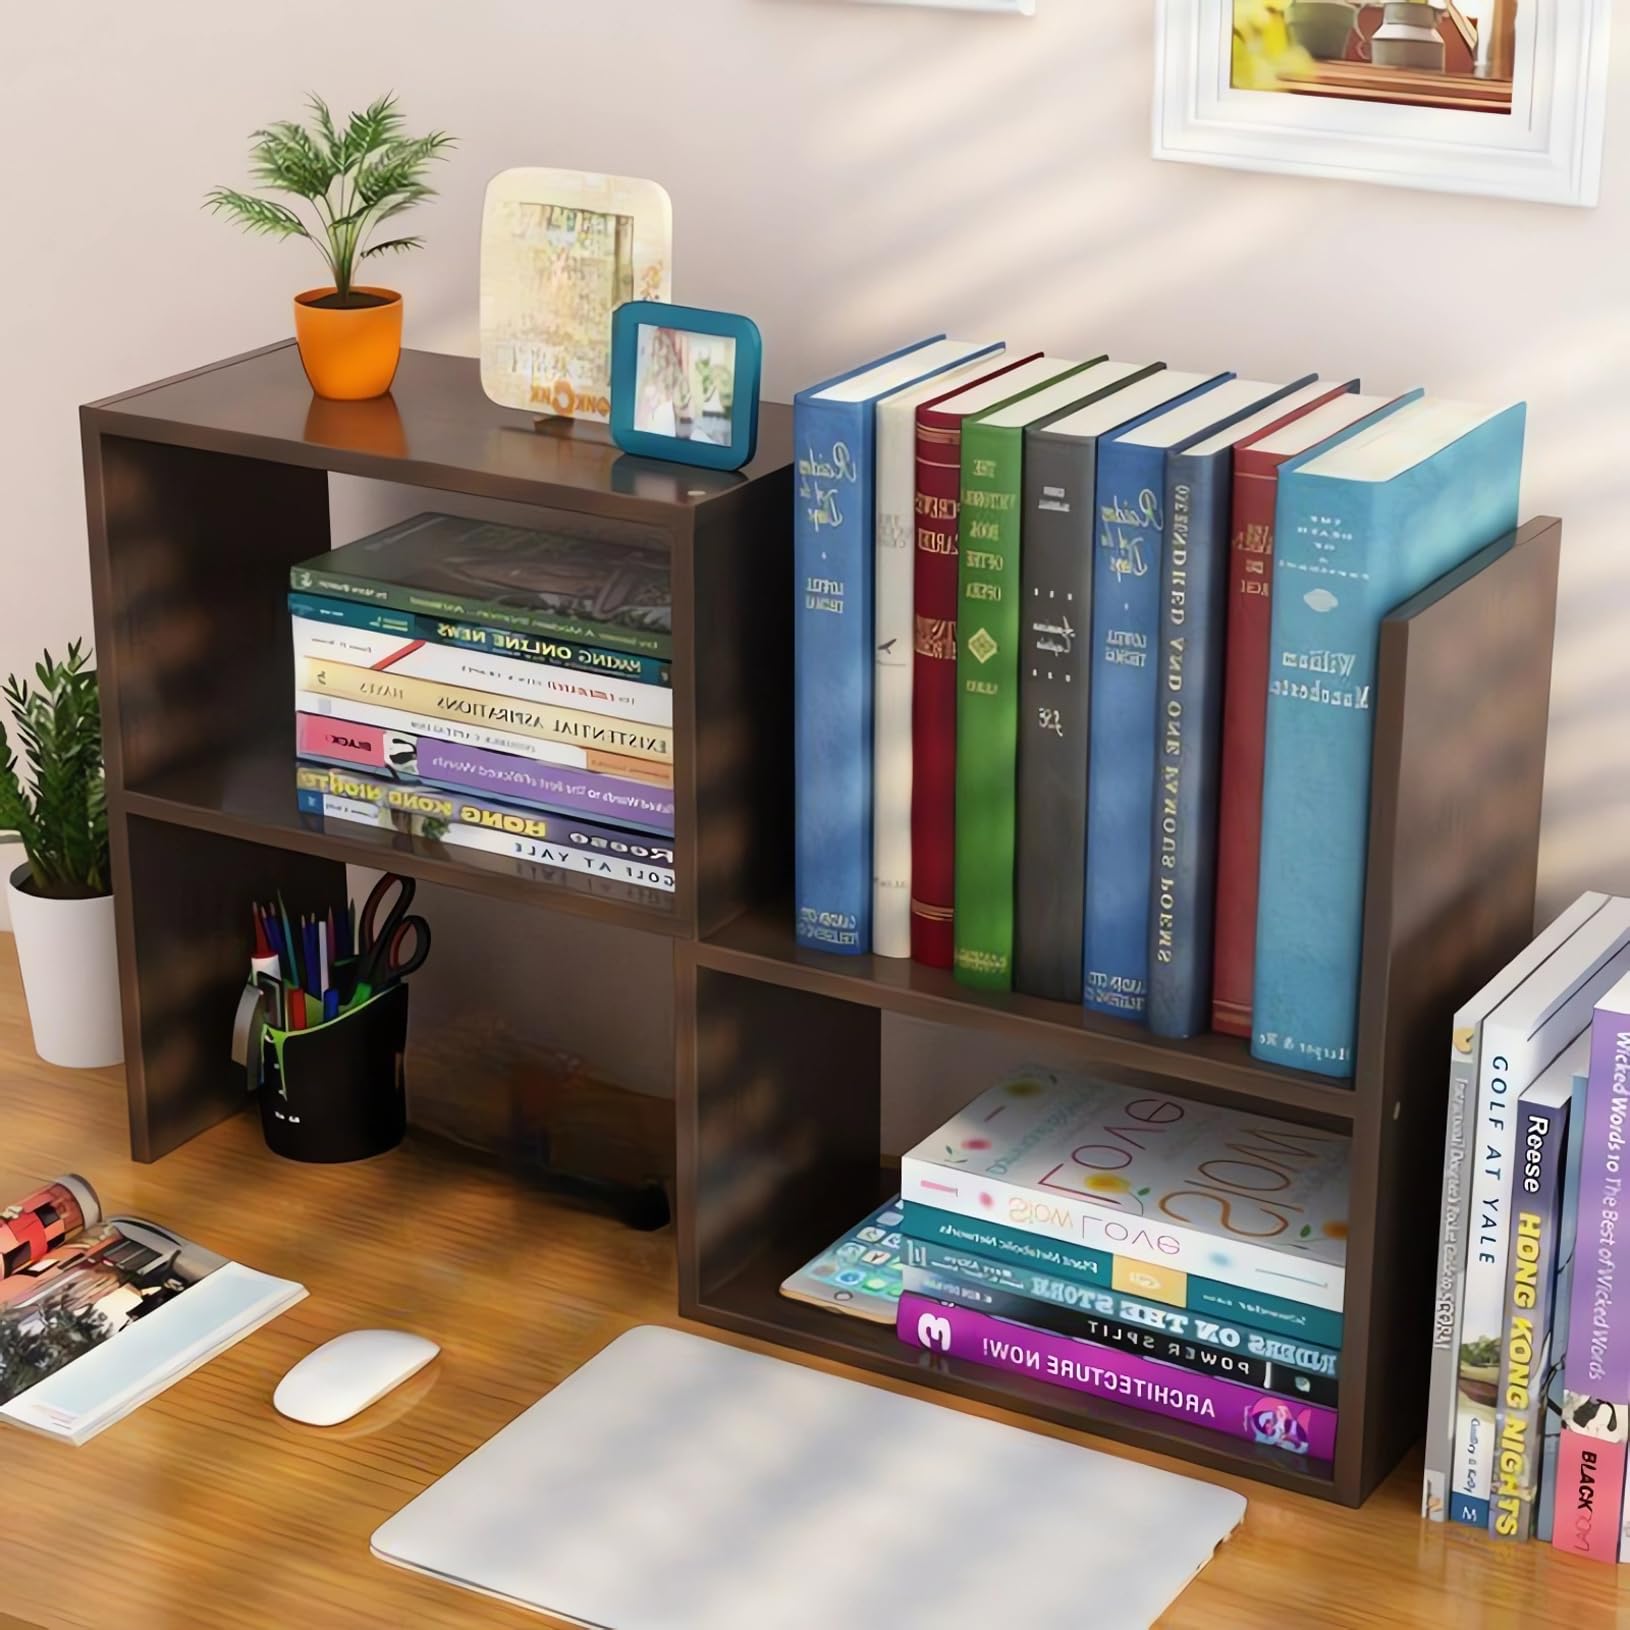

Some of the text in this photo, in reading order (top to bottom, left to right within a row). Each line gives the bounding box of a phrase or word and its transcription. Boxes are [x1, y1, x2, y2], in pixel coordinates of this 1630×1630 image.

[1607, 1096, 1628, 1151] Words
[1479, 1055, 1509, 1264] GOLF AT YALE
[1603, 1177, 1622, 1207] The
[1600, 1207, 1619, 1246] Best
[1514, 1212, 1542, 1309] HONG
[1597, 1247, 1615, 1270] of
[1593, 1269, 1614, 1328] Wicked
[1505, 1317, 1533, 1410] KONG
[1589, 1328, 1608, 1381] Words
[1495, 1415, 1528, 1537] NIGHTS
[1577, 1450, 1597, 1511] BLACK
